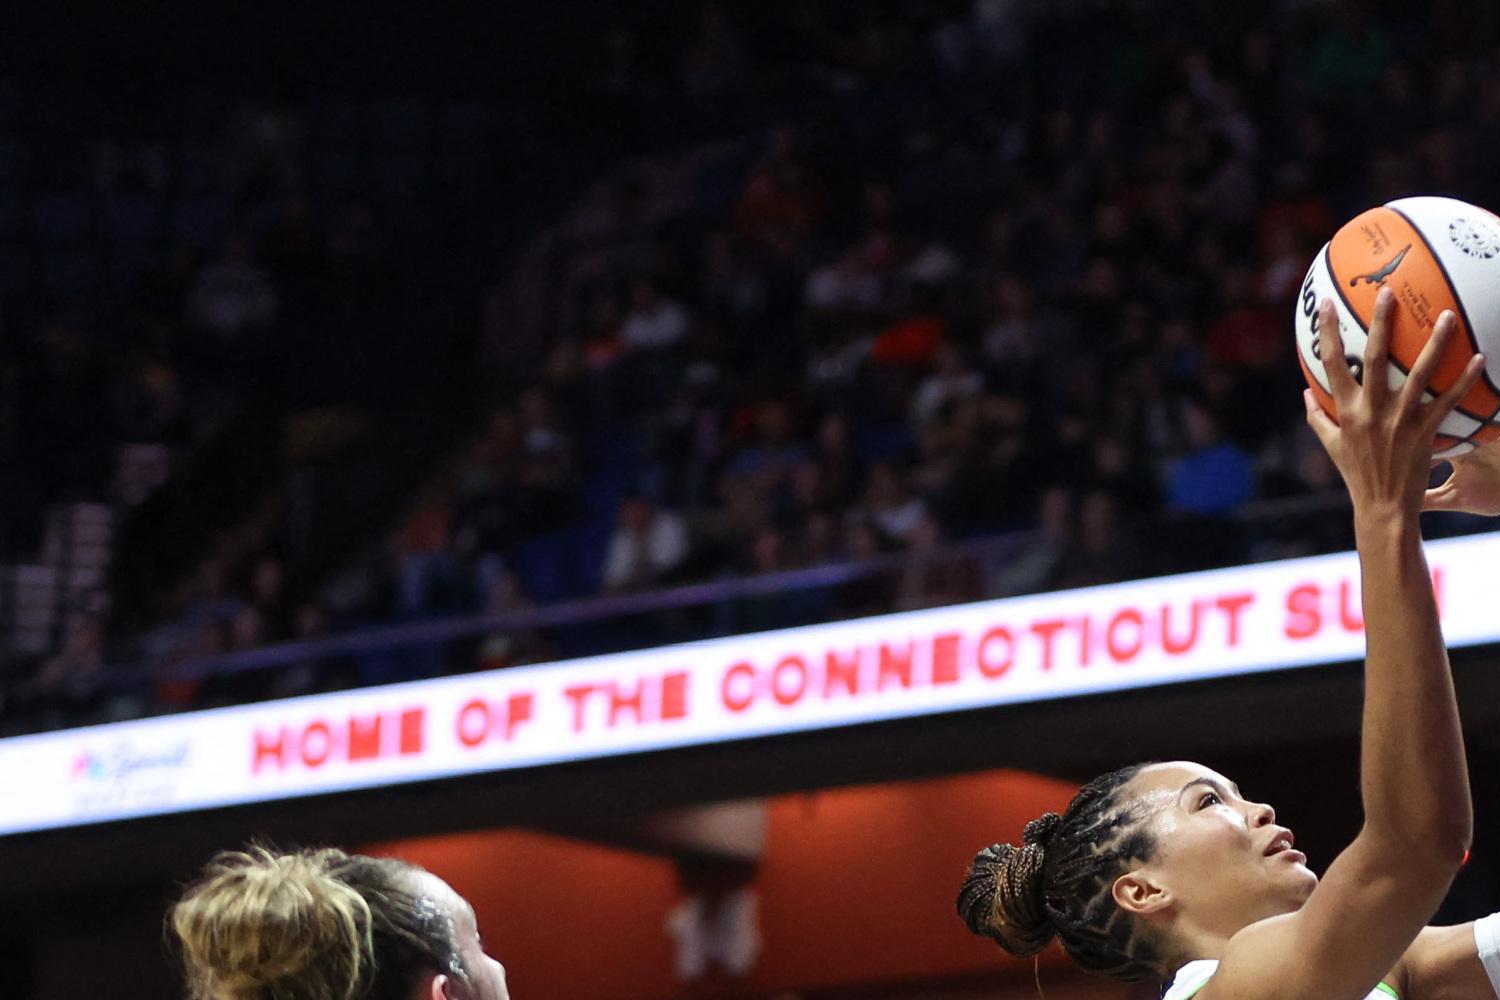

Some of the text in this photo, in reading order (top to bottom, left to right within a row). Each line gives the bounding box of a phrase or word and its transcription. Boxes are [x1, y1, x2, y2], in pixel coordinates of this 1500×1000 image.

[252, 707, 426, 769] HOME
[456, 692, 539, 750] OF
[563, 670, 690, 731] THE
[721, 591, 1256, 714] CONNECTICUT
[1283, 569, 1443, 641] SU
